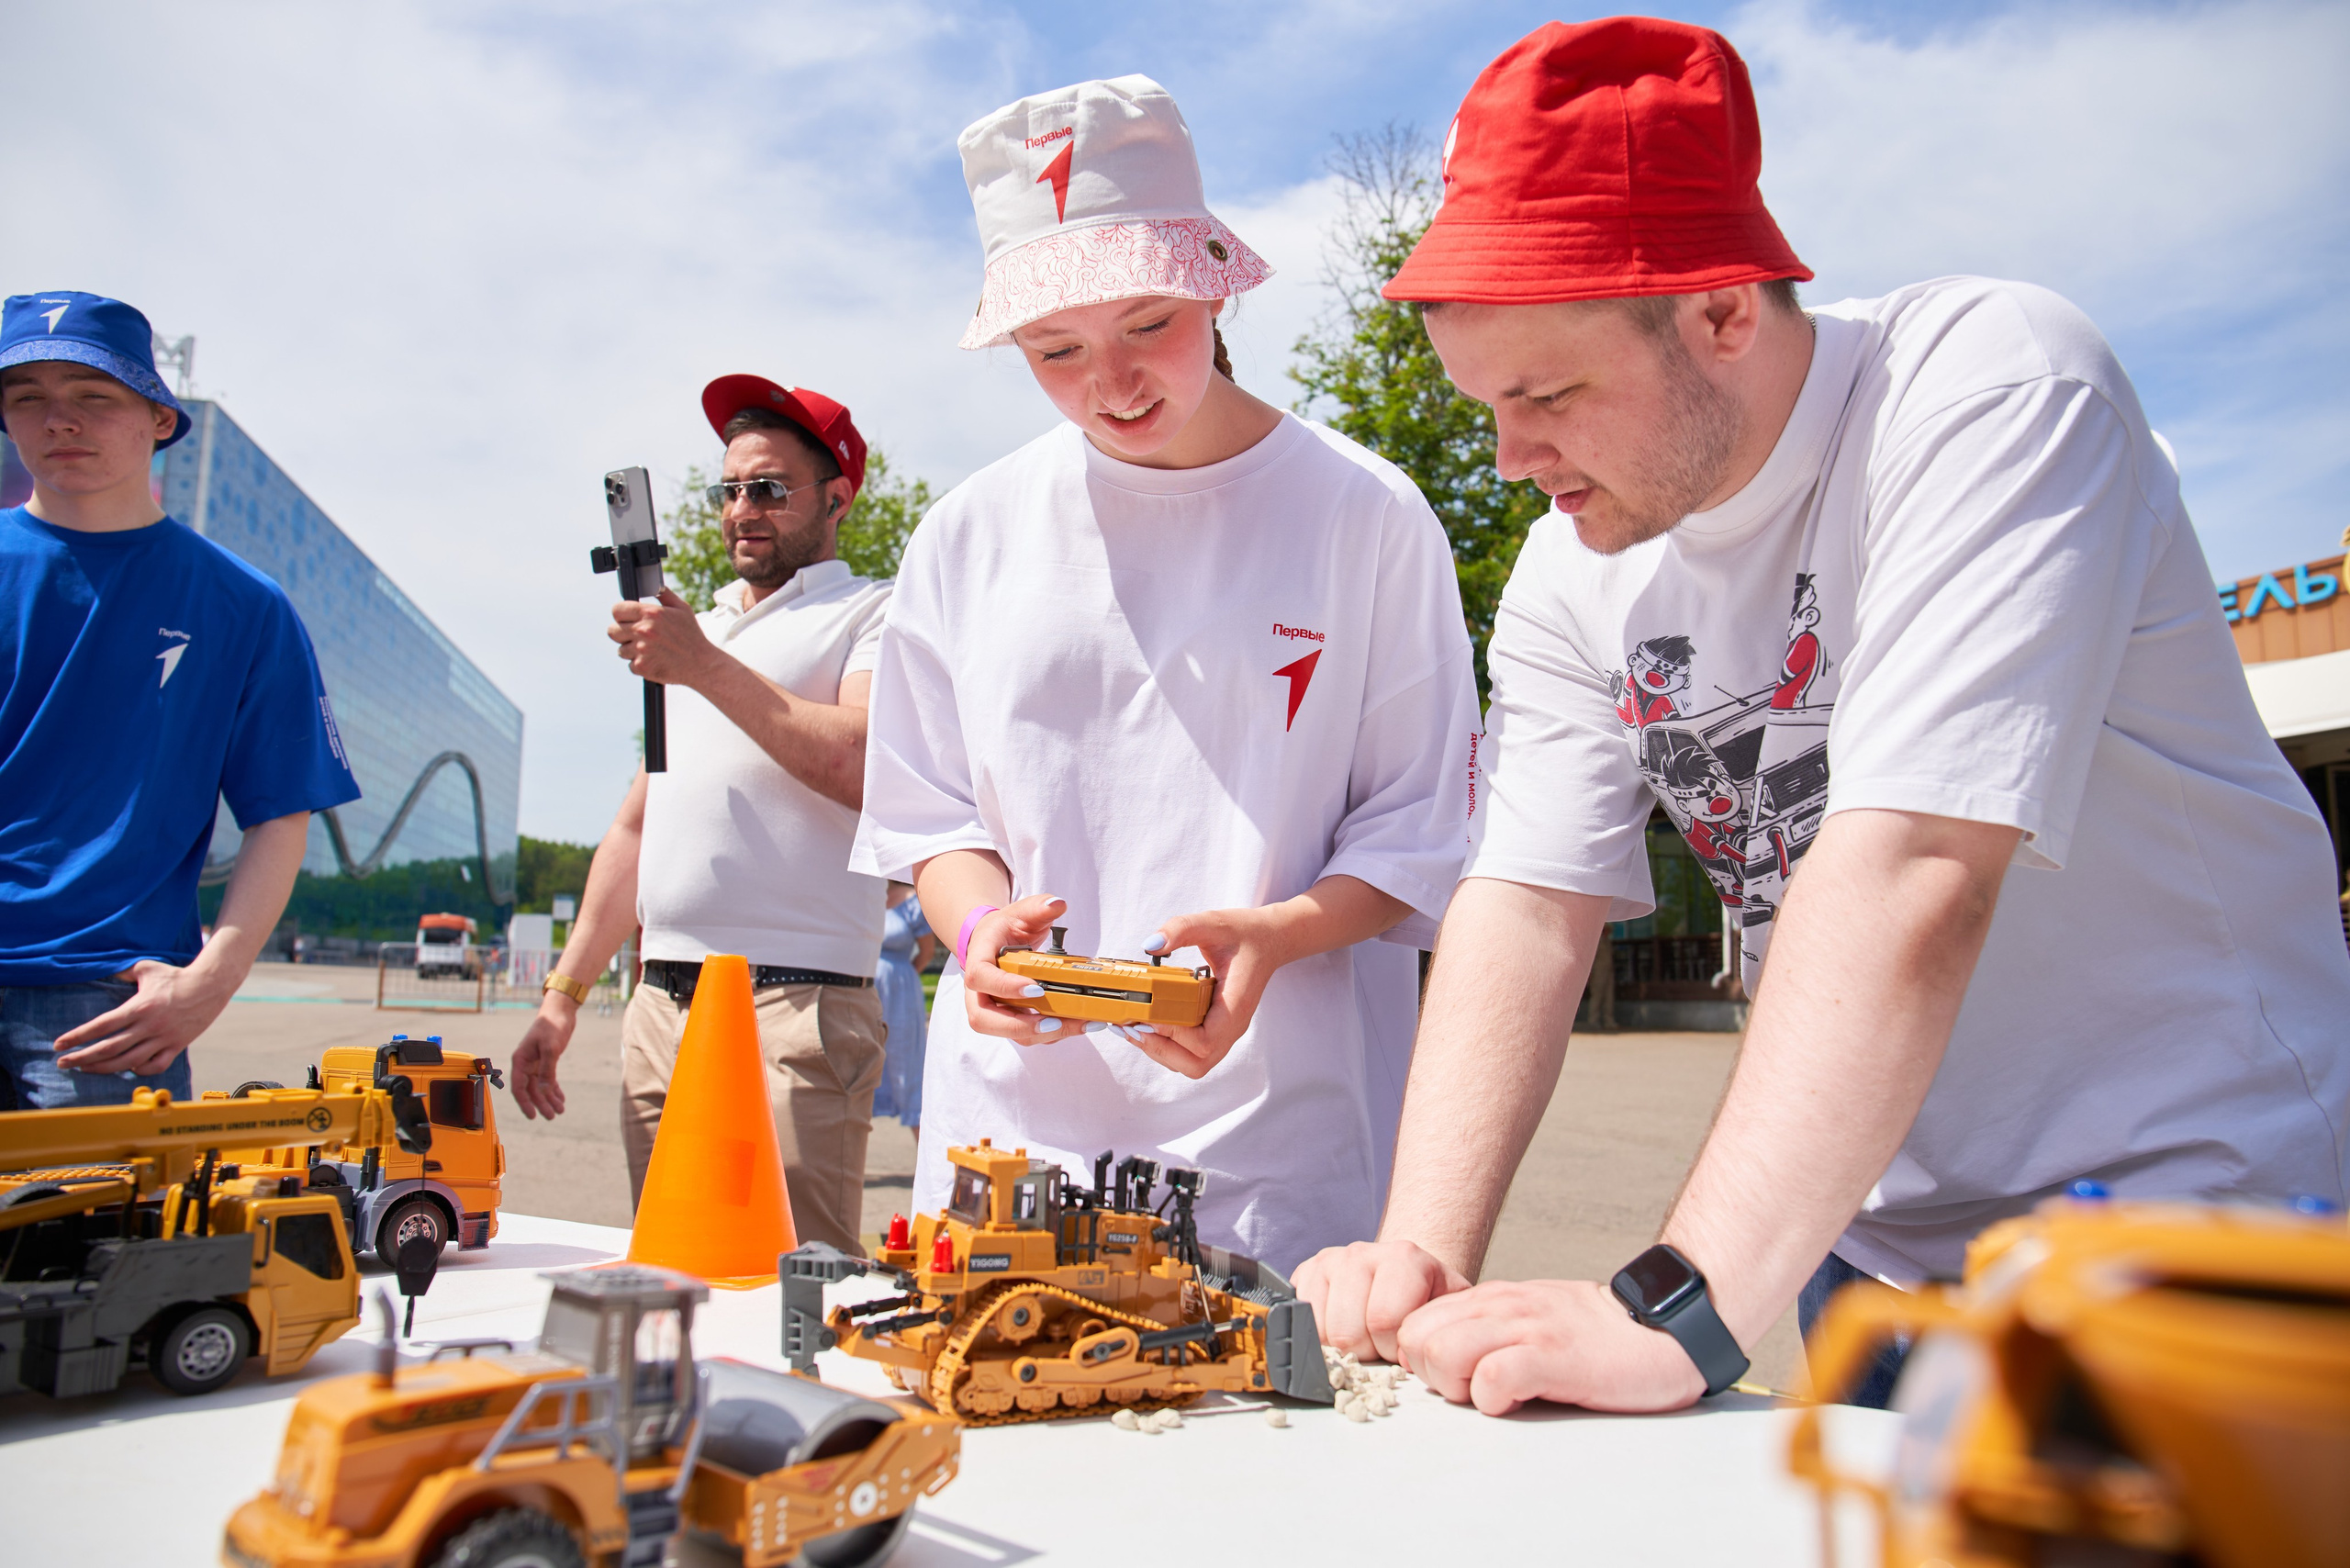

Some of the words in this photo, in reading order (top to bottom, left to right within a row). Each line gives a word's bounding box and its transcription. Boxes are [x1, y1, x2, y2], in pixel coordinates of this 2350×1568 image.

[1025, 126, 1073, 150] Первые
[1272, 623, 1325, 643] Первые
[1469, 733, 1477, 767] детей
[970, 1258, 1009, 1268] YIGONG
